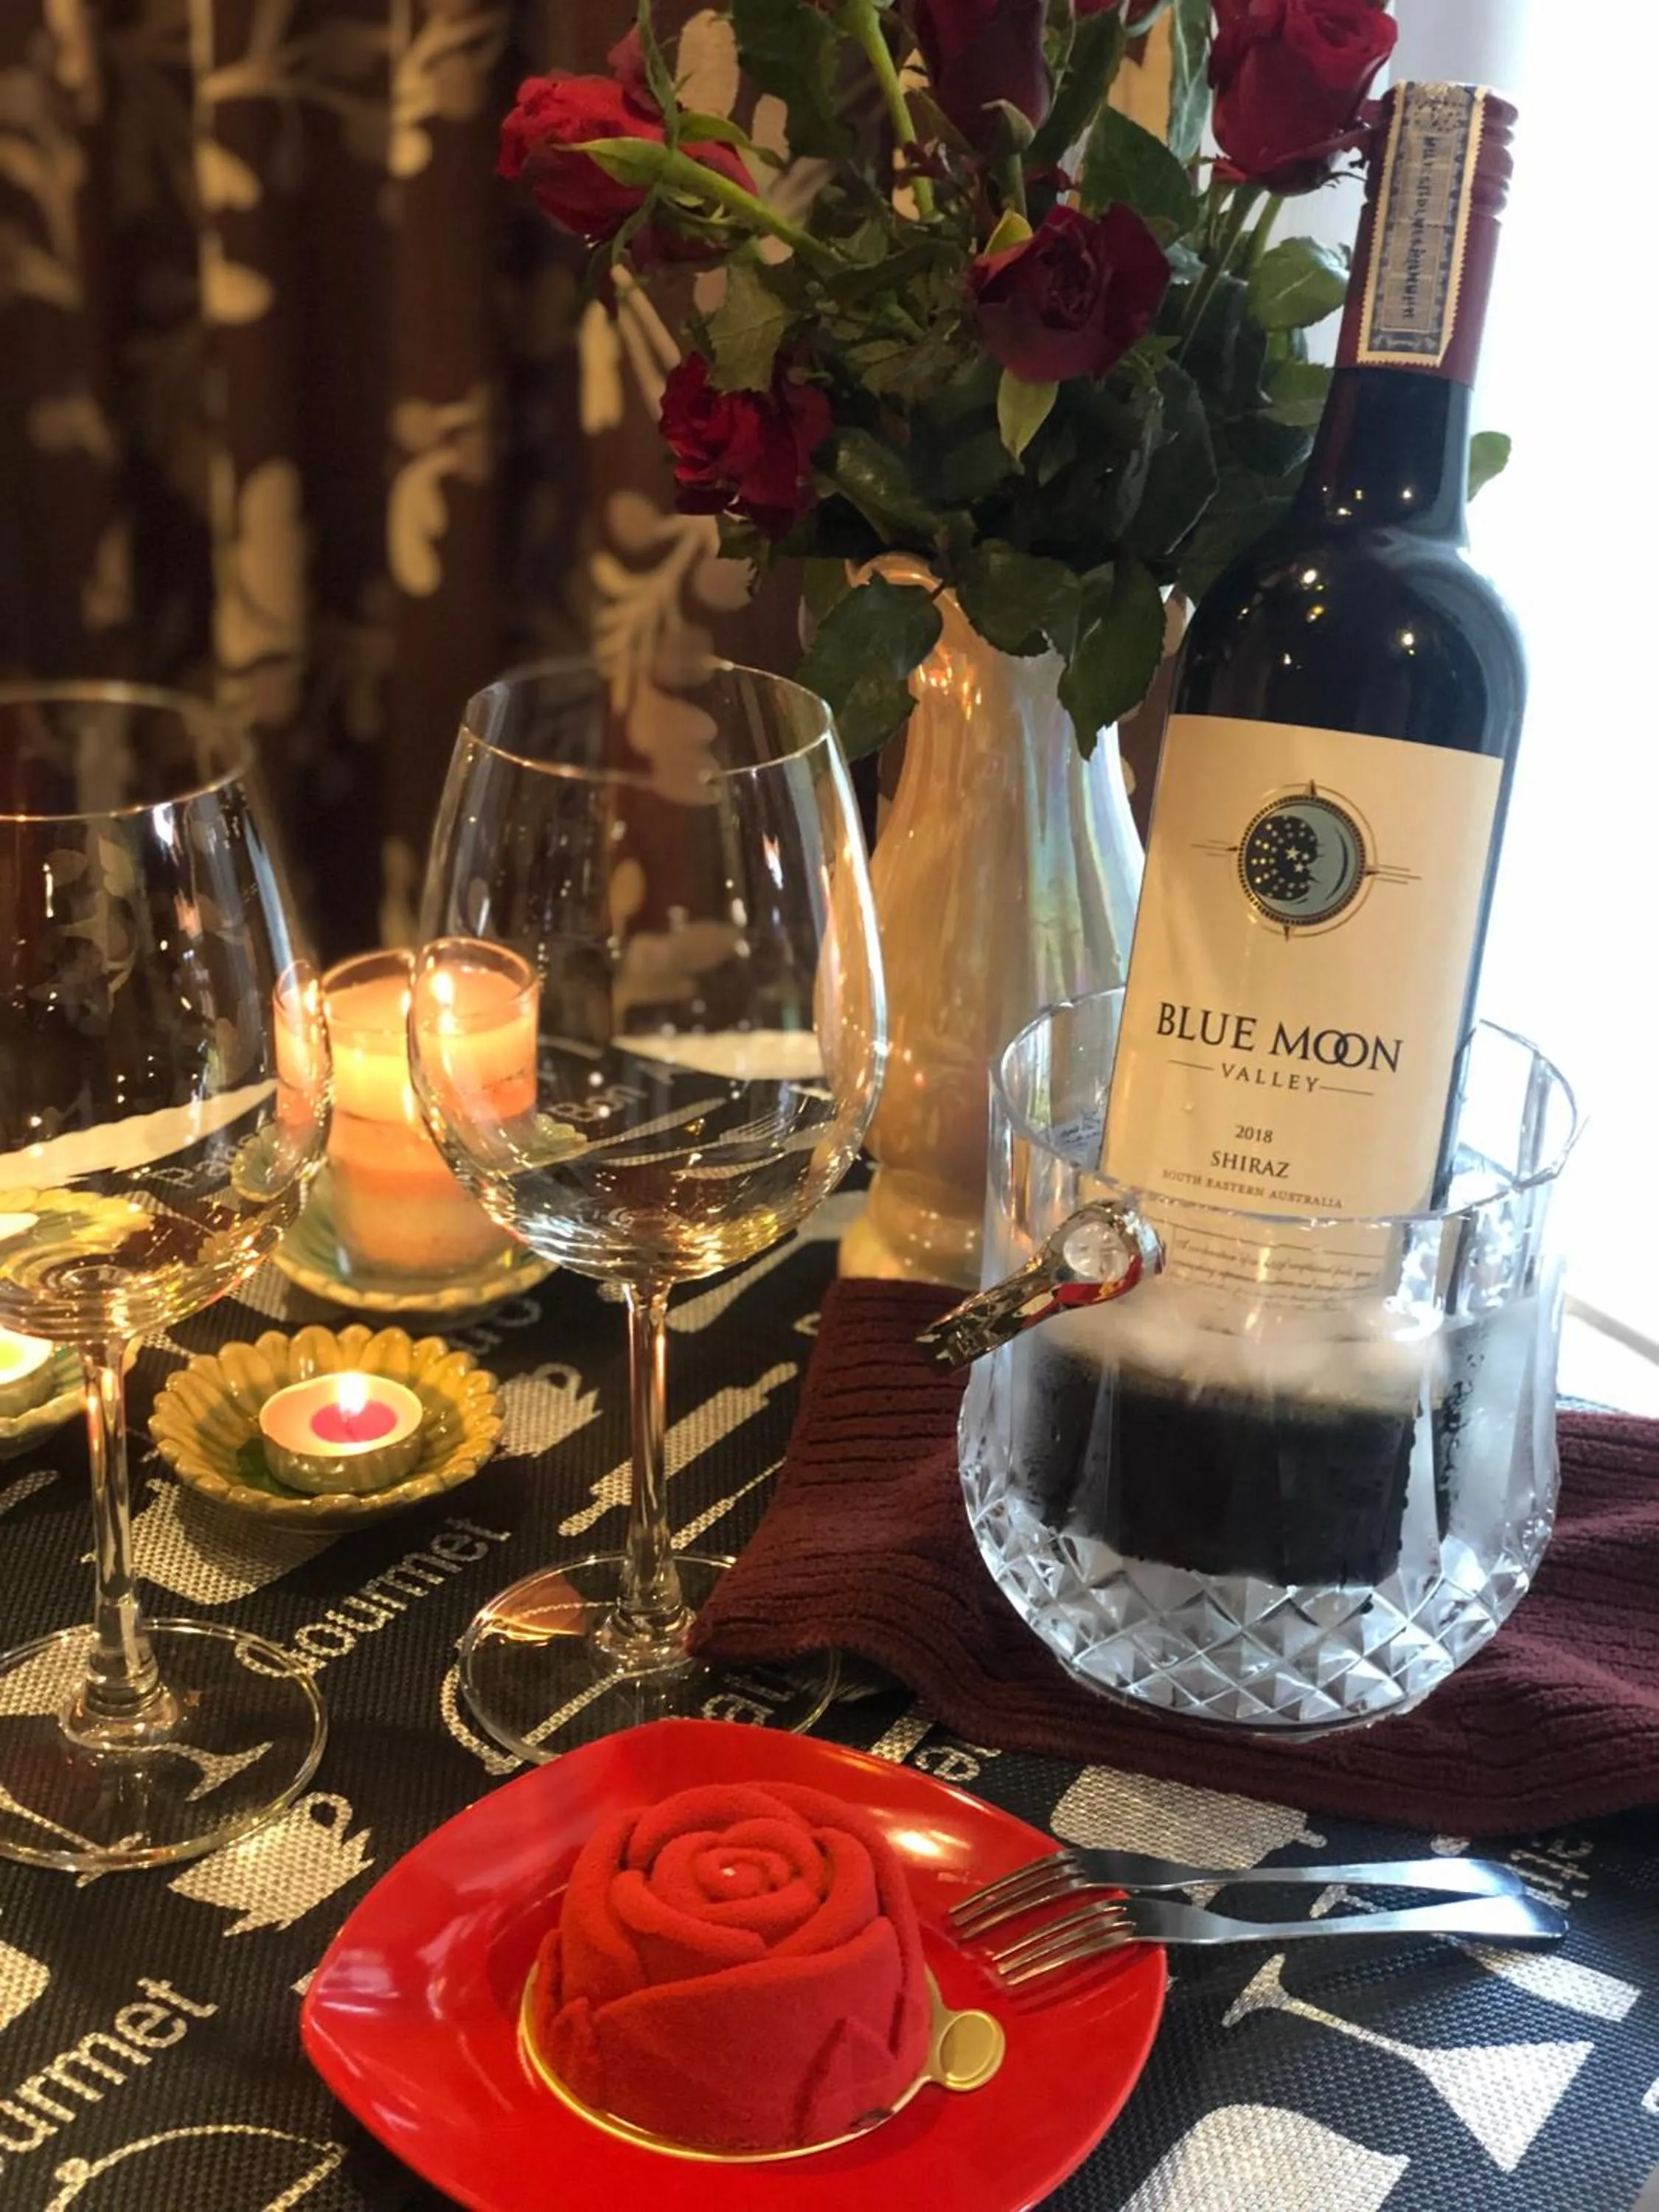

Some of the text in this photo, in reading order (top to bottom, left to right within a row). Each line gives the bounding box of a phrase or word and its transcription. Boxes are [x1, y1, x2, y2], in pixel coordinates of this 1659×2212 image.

[1156, 1002, 1404, 1073] BLUE MOON
[1221, 1062, 1320, 1093] VALLEY
[1234, 1124, 1274, 1144] 2018
[1209, 1150, 1290, 1179] SHIRAZ
[1162, 1169, 1343, 1209] SOUTH EASTERN AUSTRALIA
[0, 1977, 219, 2153] urmet
